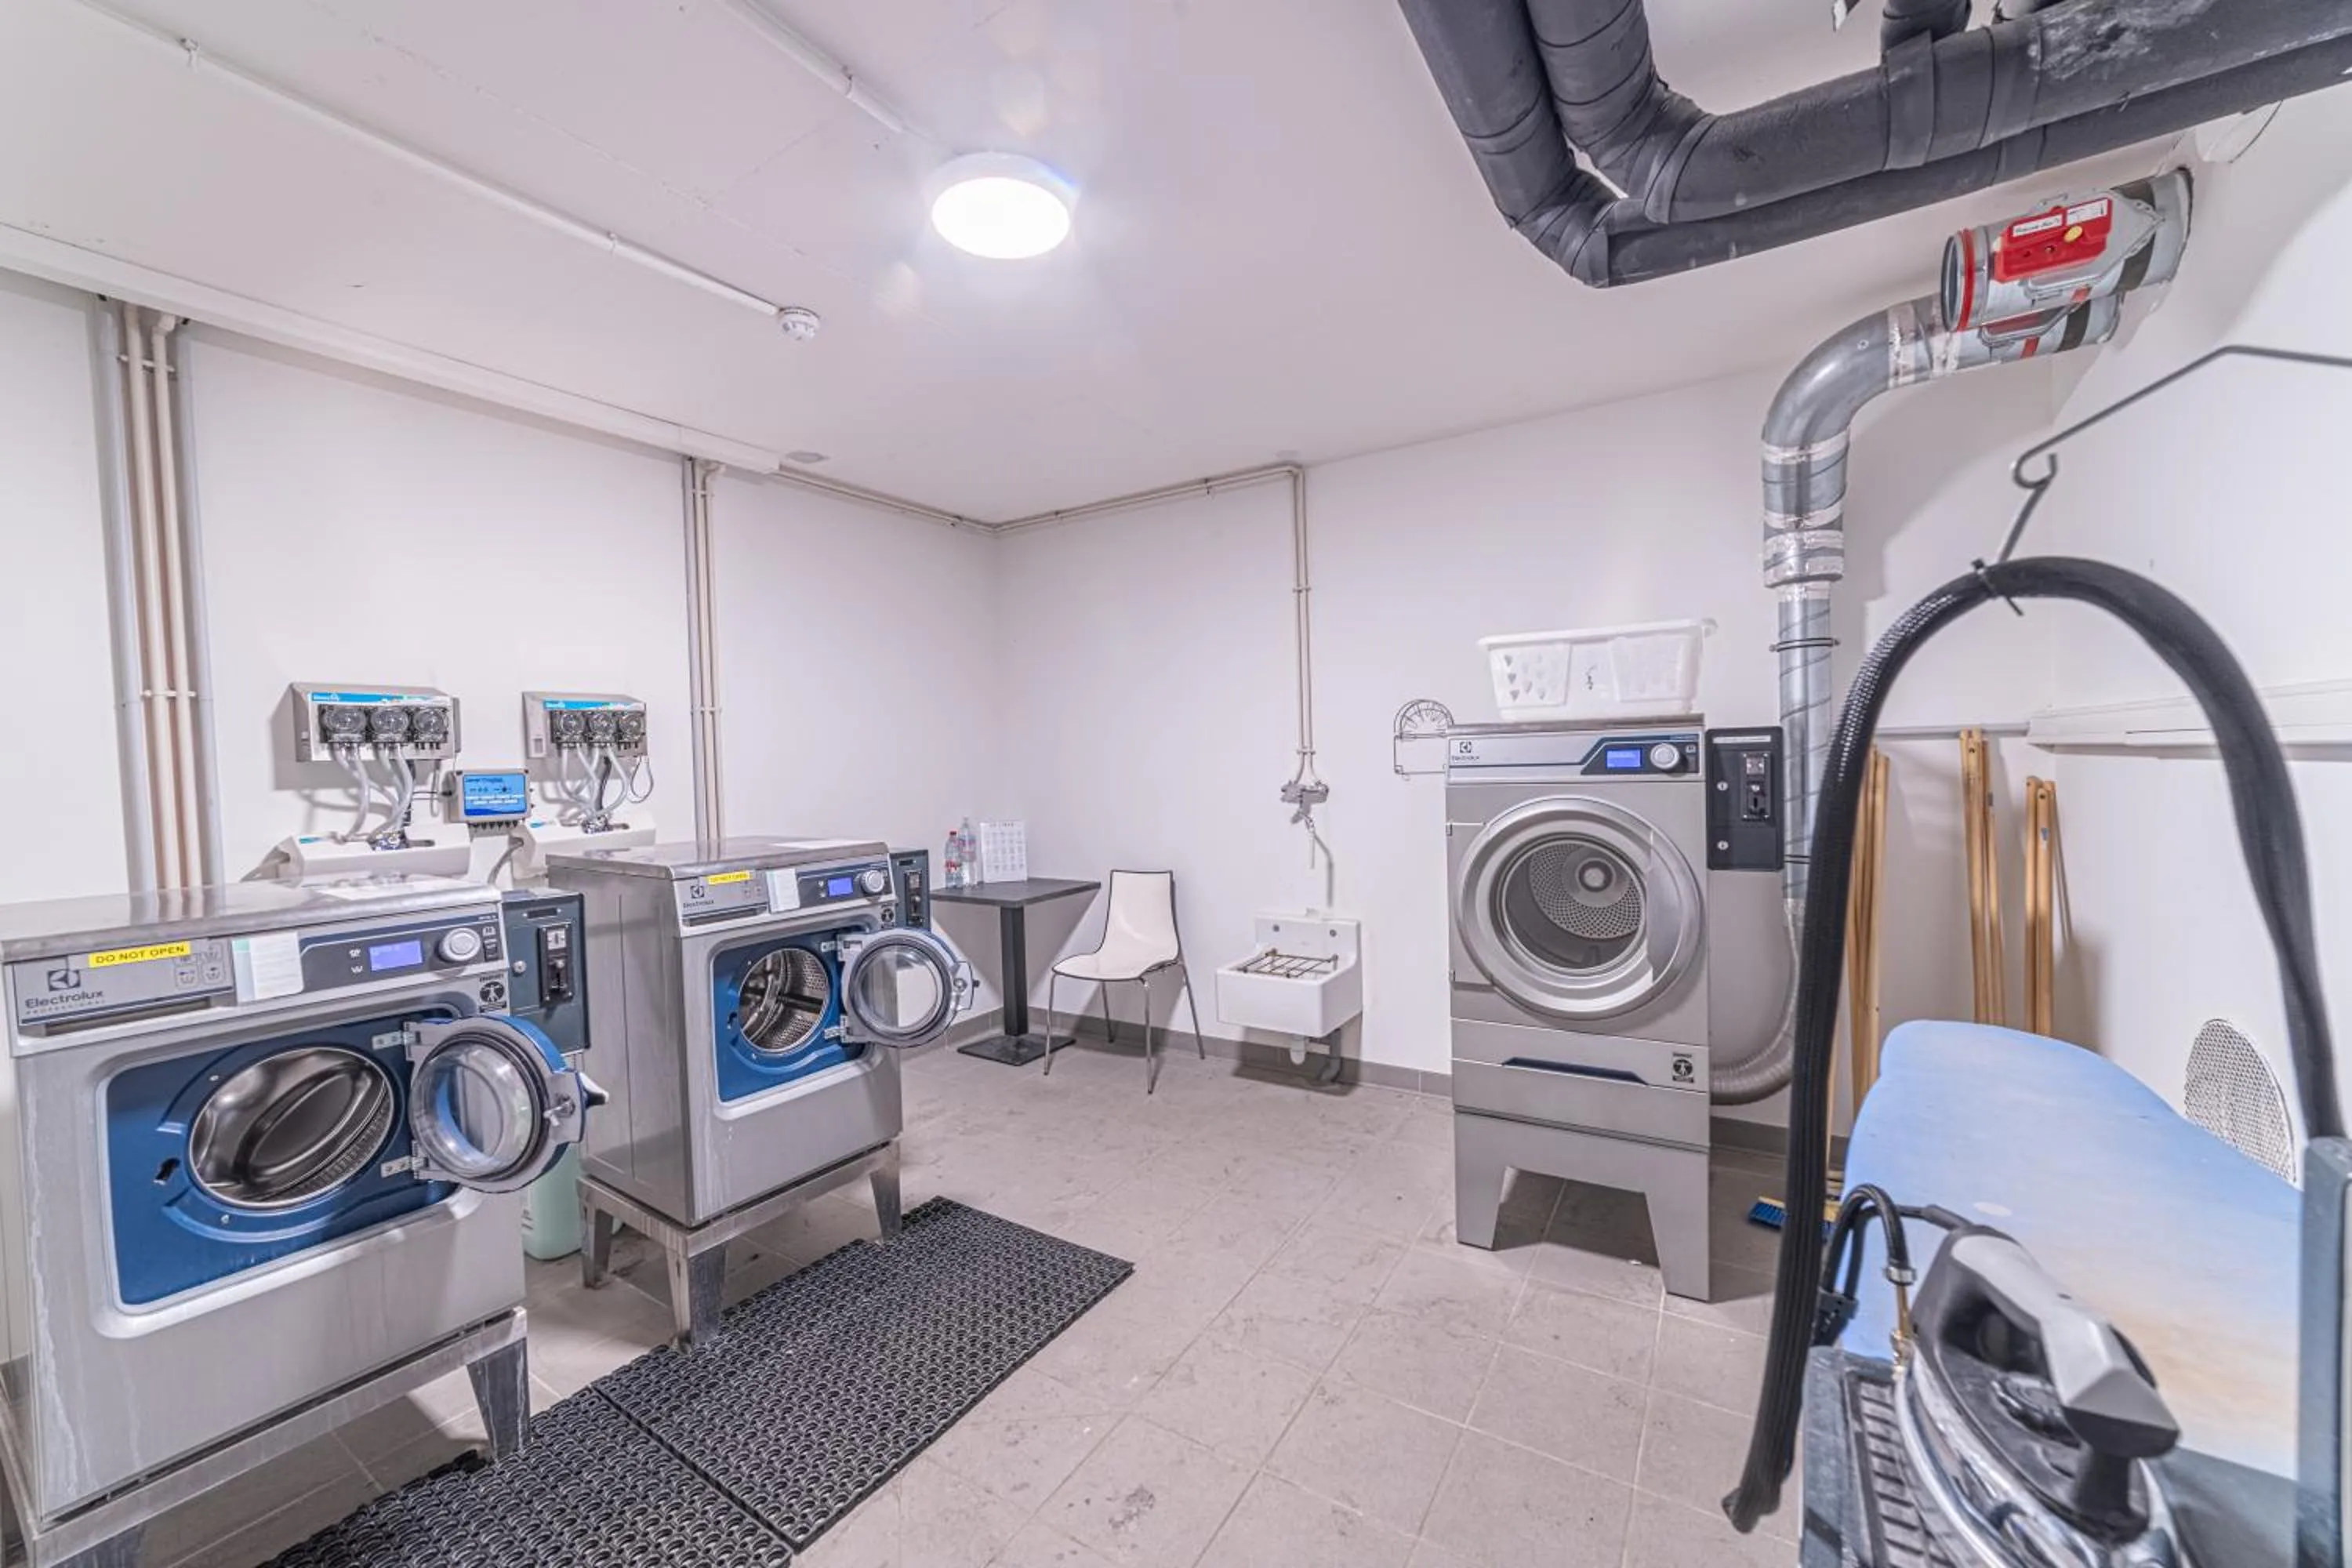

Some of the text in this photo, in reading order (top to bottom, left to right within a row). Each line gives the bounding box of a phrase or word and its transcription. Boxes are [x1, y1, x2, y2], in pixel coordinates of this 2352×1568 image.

[95, 945, 184, 964] DO NOT OPEN
[24, 991, 103, 1009] Electrolux
